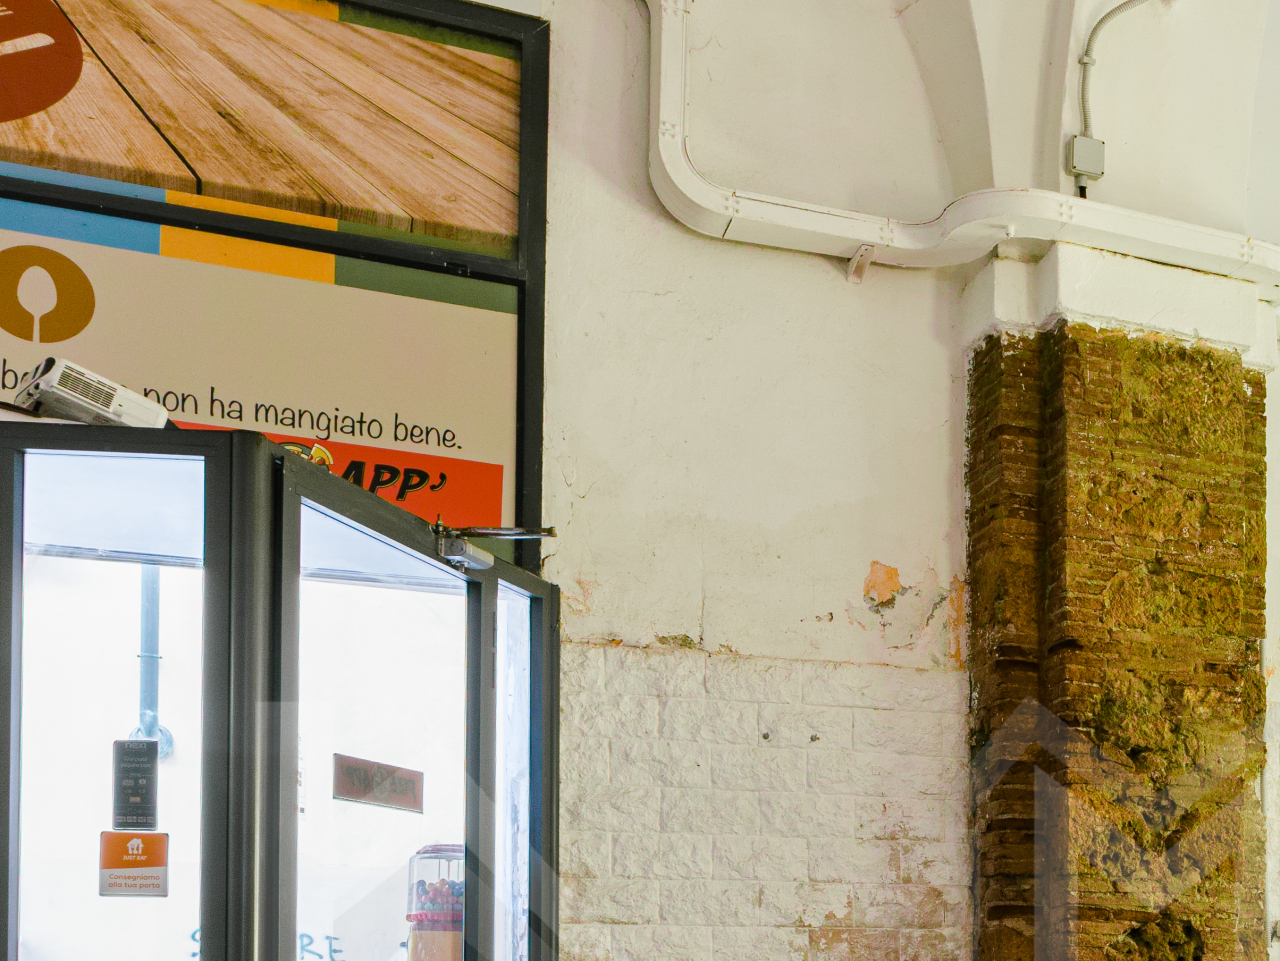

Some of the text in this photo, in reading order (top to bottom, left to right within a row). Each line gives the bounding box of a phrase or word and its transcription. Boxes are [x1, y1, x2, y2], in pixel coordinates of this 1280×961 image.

[143, 386, 463, 450] non ha mangiato bene.
[108, 873, 161, 883] Consegniamo
[139, 882, 161, 890] porta
